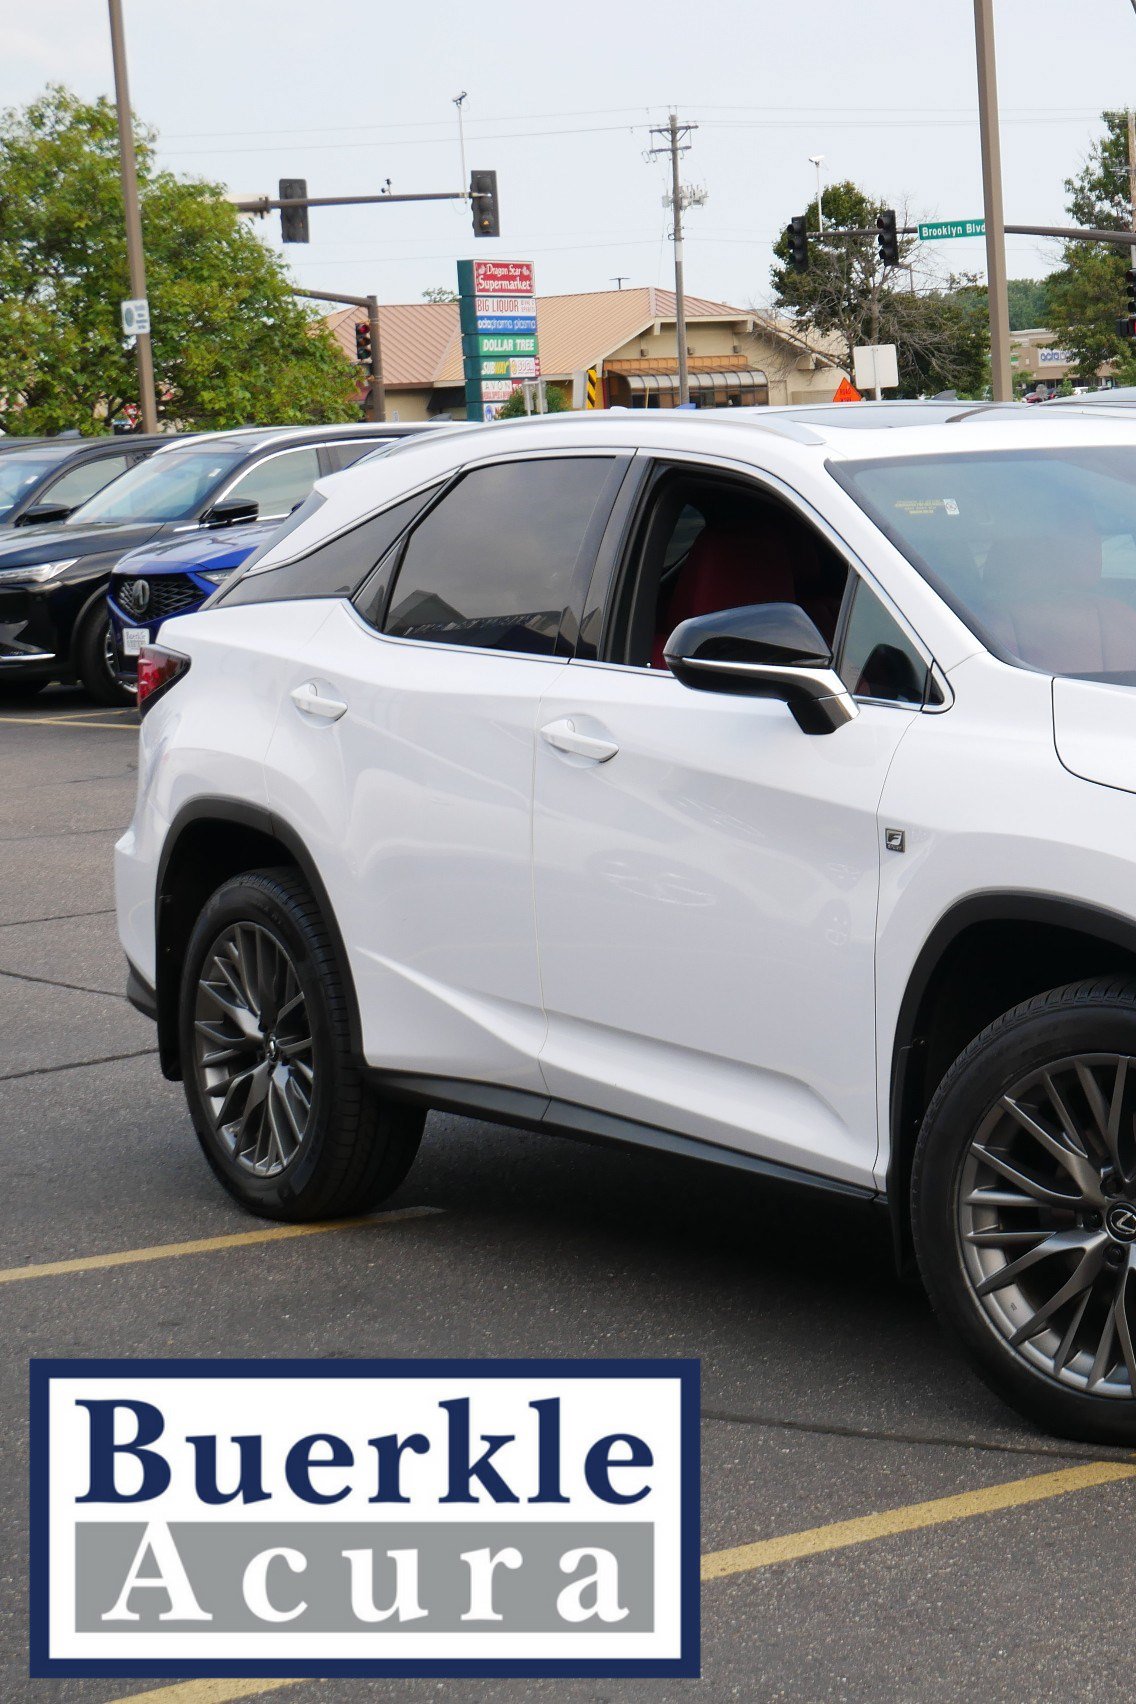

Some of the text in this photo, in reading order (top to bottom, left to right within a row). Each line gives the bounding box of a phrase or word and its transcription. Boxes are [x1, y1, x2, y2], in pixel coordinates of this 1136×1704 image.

[922, 222, 985, 236] Brooklyn Blvd
[486, 264, 521, 277] Dragon Star
[479, 275, 530, 291] Supermarket
[477, 299, 519, 313] BIG LIQUOR
[514, 319, 536, 330] plasma
[483, 339, 534, 351] DOLLAR TREE
[481, 361, 510, 375] SUBWAY
